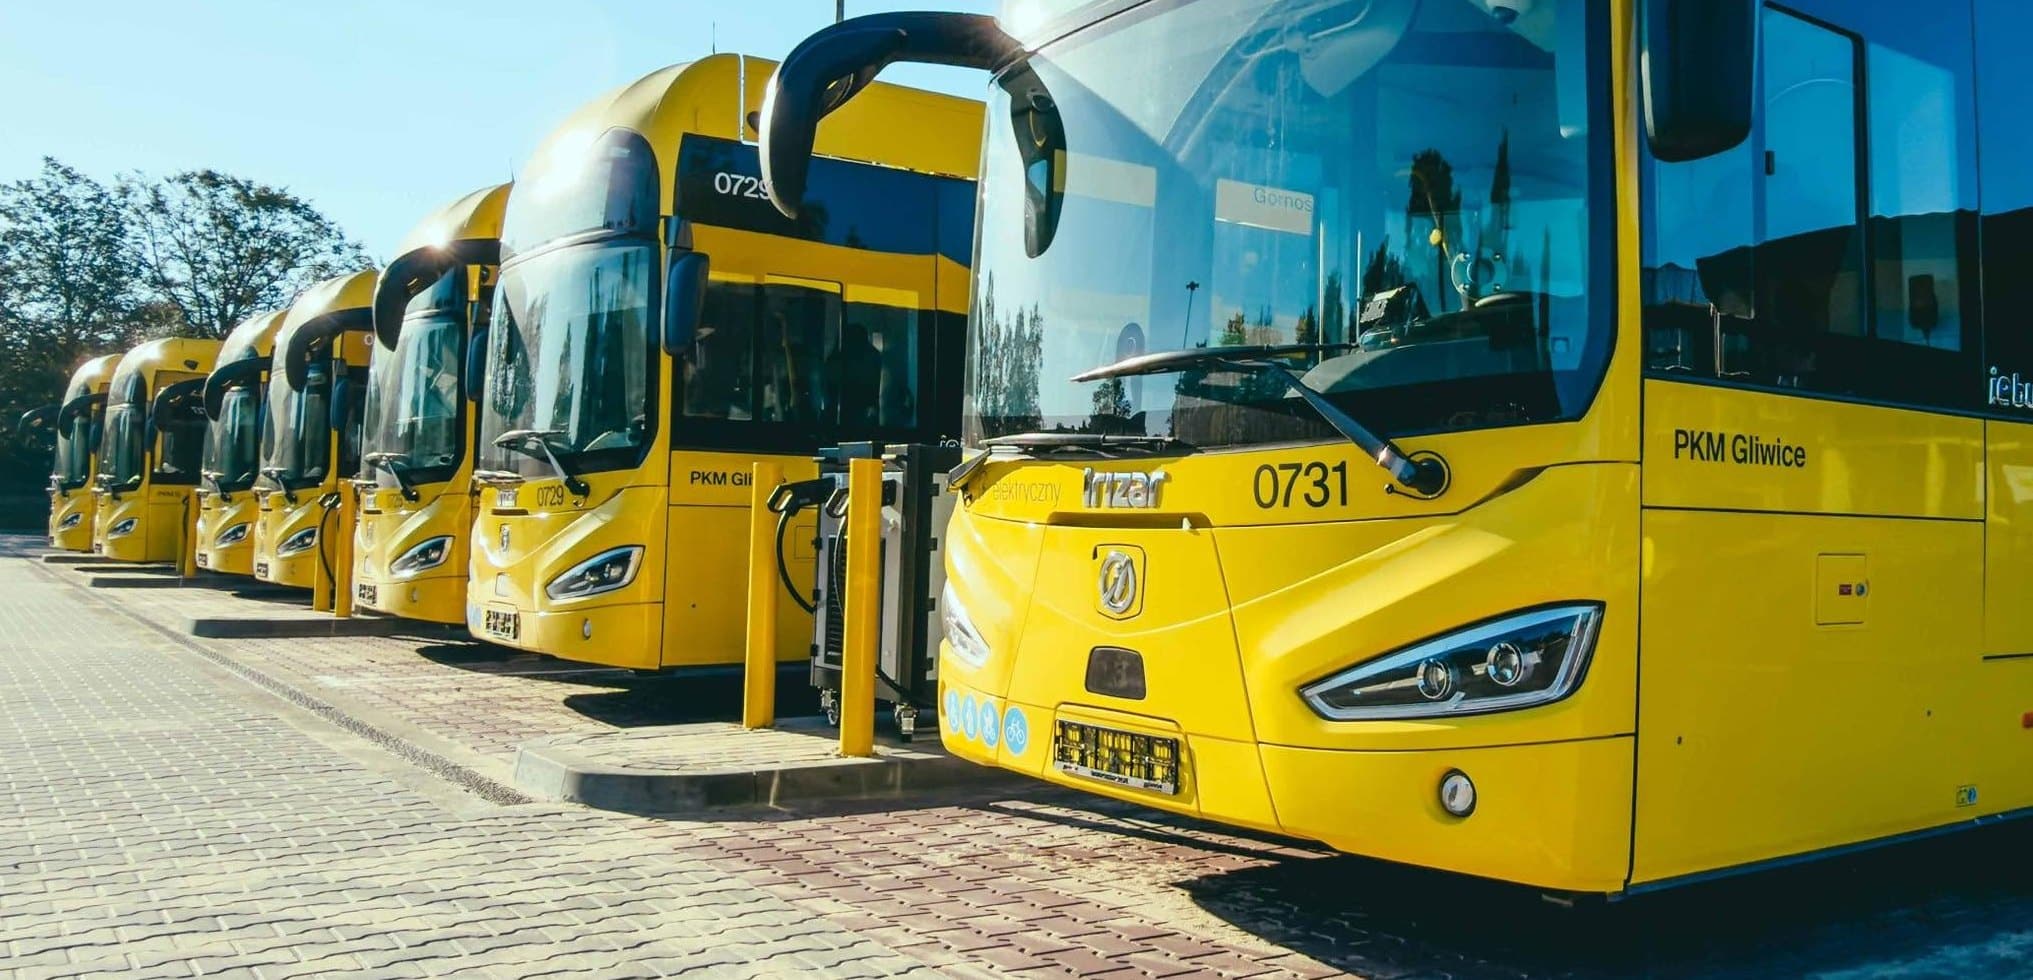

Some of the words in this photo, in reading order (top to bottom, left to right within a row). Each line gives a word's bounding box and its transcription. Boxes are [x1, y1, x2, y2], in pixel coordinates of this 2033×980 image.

[1674, 428, 1725, 462] PKM
[1732, 434, 1806, 468] Gliwice
[690, 471, 727, 485] PKM
[1253, 460, 1347, 509] 0731
[536, 485, 564, 507] 0729
